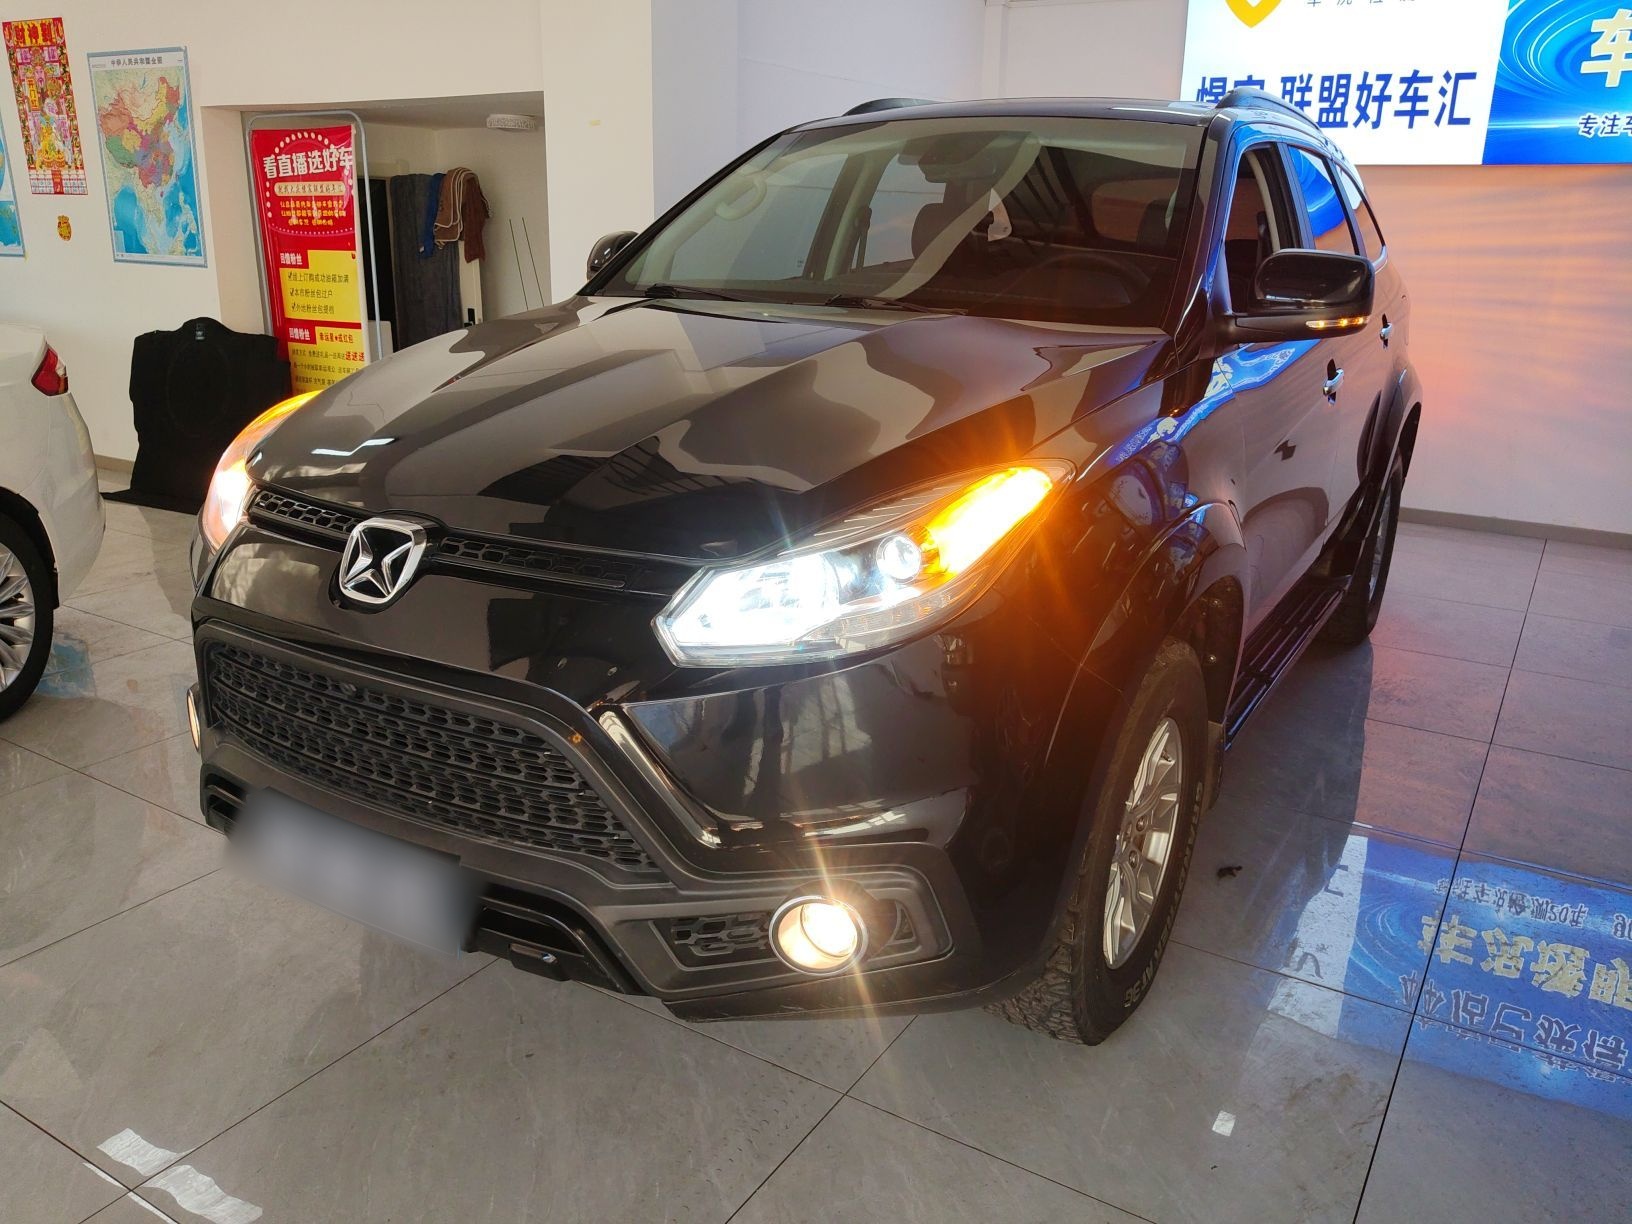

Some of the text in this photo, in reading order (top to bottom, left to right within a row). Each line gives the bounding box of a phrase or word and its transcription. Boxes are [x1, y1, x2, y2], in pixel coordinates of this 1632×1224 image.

[263, 146, 353, 179] 看直播选好车
